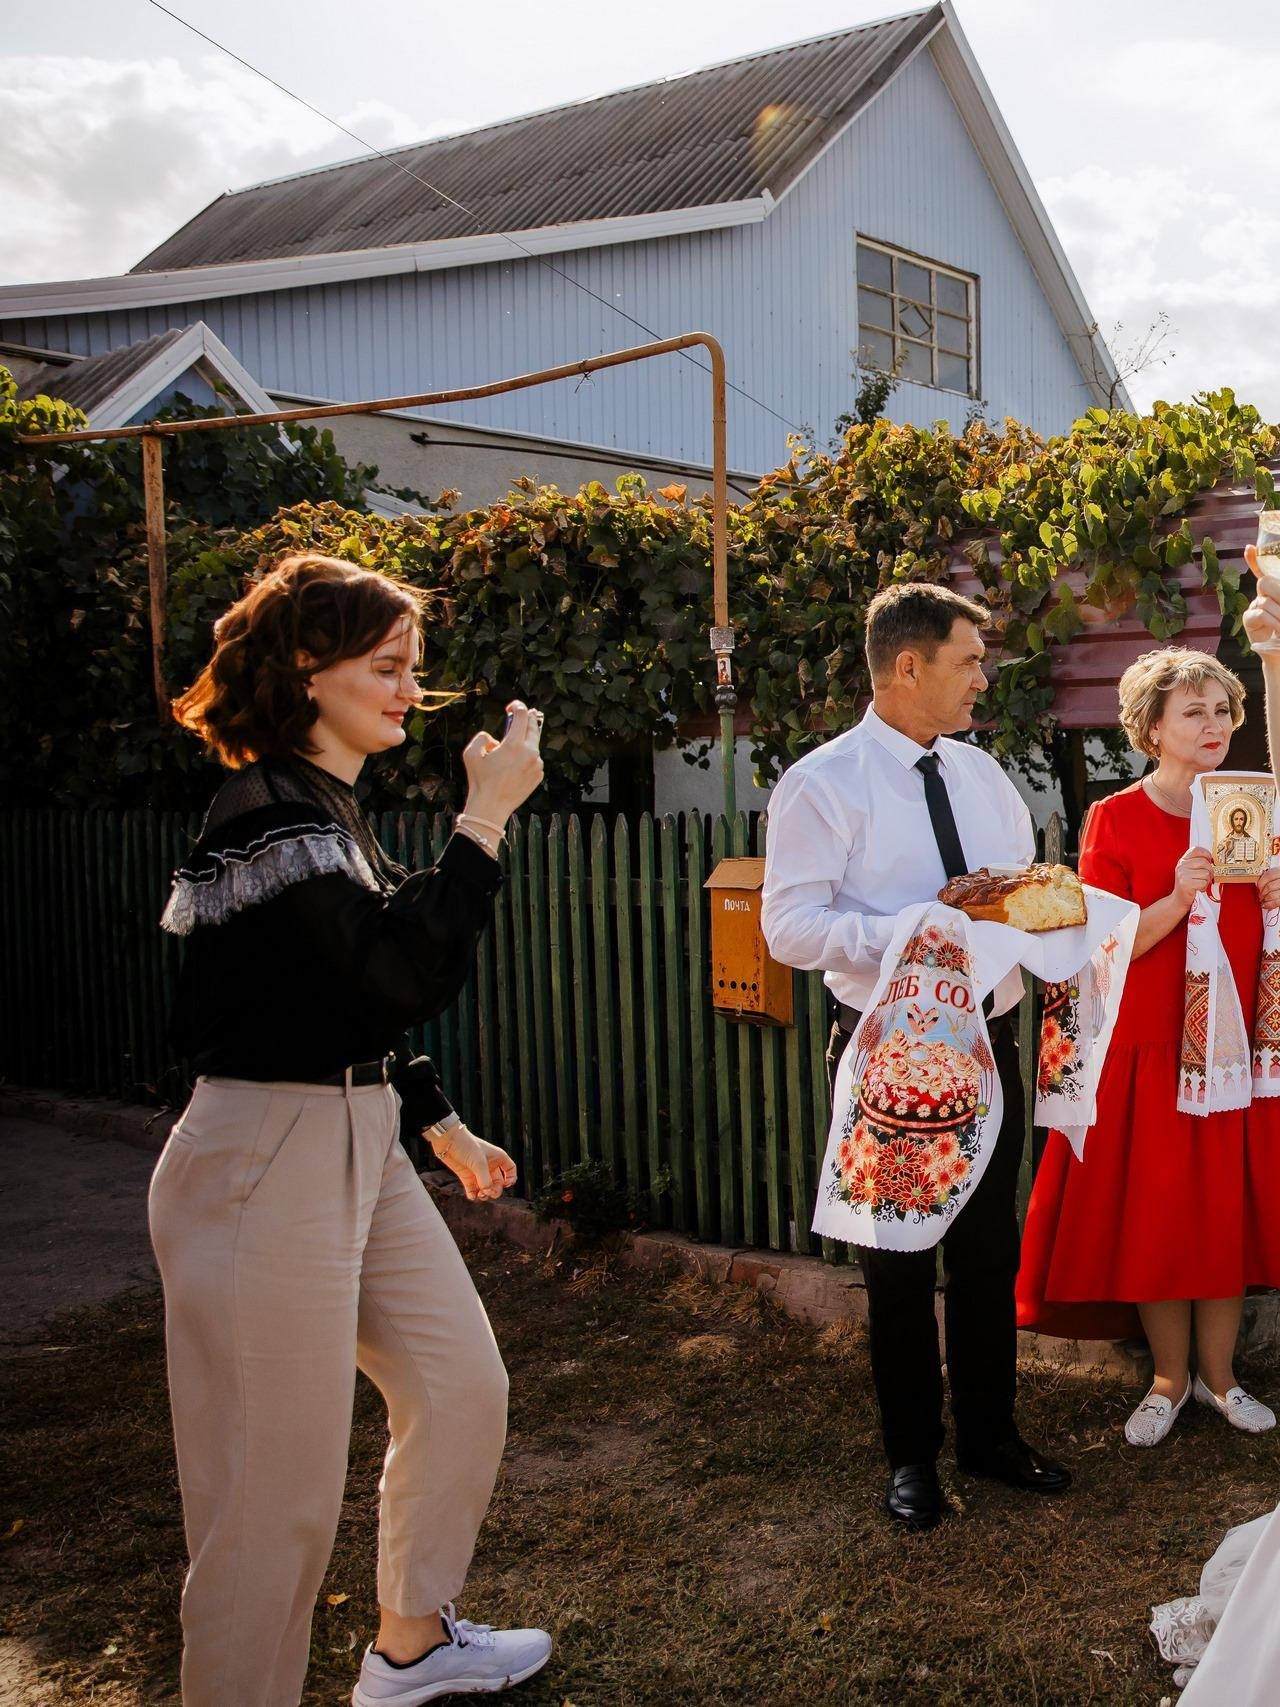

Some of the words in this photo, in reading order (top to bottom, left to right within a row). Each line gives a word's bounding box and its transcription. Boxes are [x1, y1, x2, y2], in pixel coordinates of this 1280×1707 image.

[724, 898, 751, 912] ПОЧТА
[878, 975, 920, 1006] ЛЕБ
[935, 980, 977, 1013] СО
